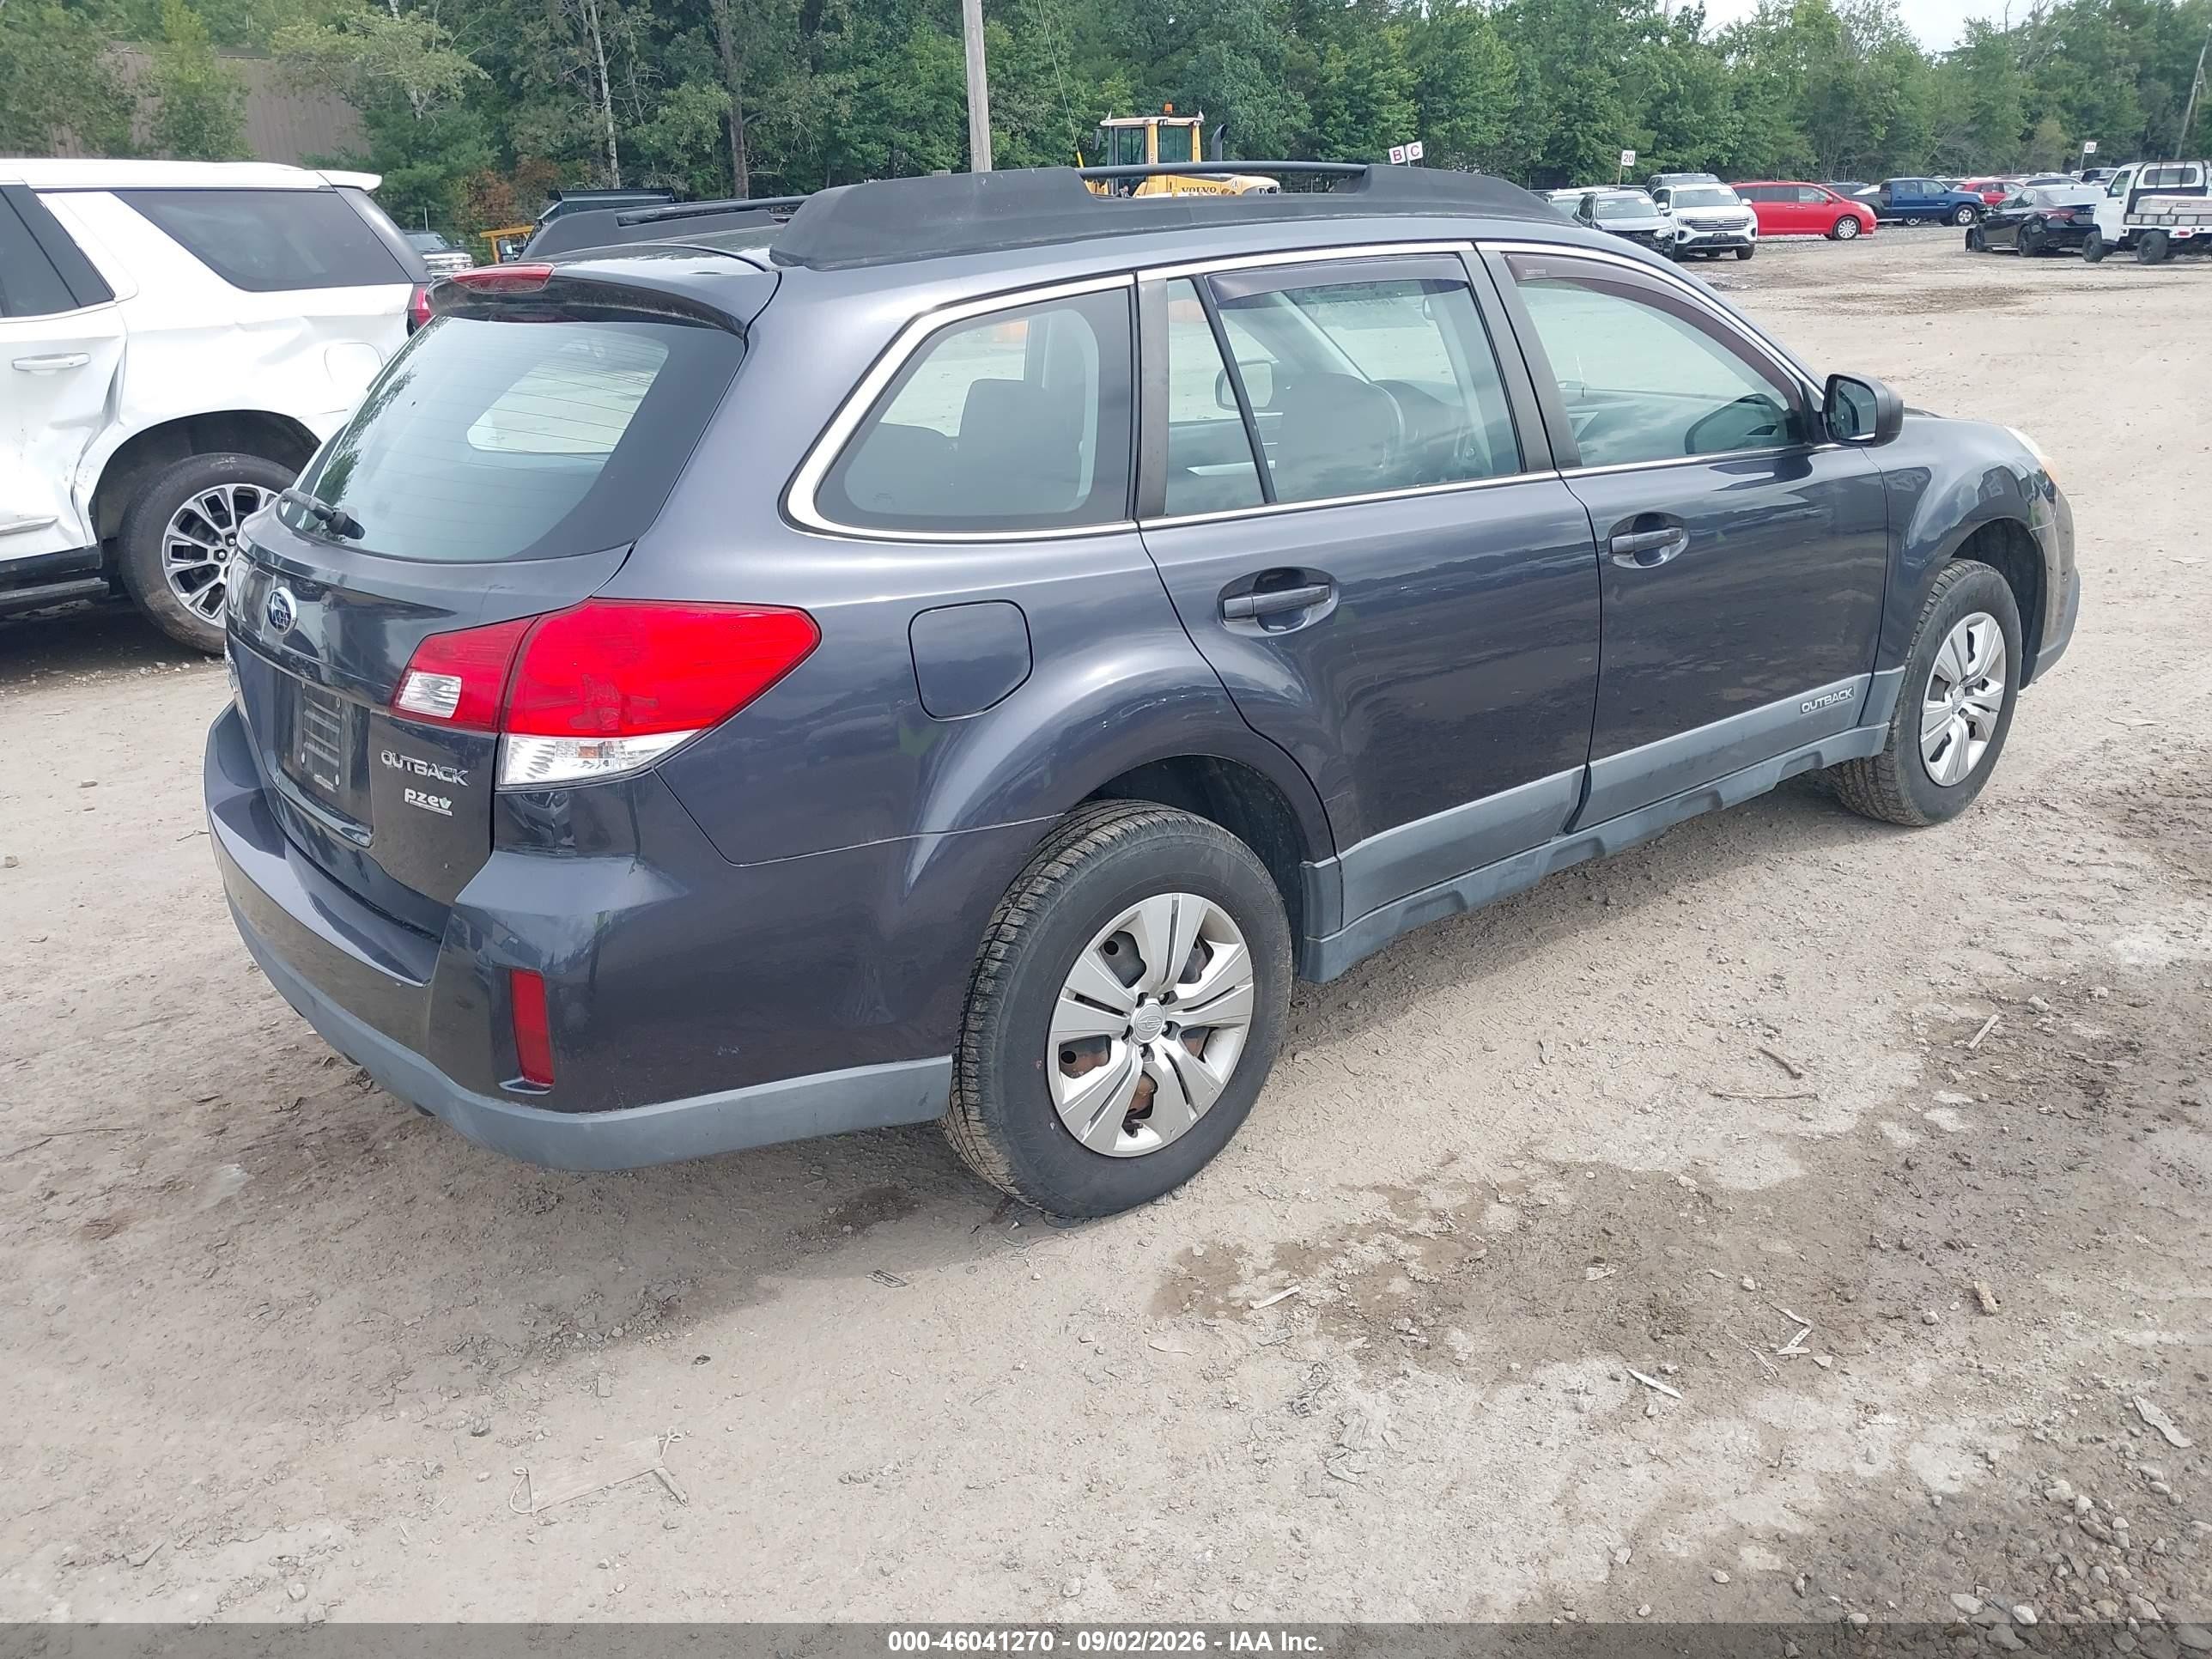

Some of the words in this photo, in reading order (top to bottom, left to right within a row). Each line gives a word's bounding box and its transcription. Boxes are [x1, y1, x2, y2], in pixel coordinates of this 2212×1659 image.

[1393, 149, 1402, 161] B
[1410, 145, 1419, 156] C
[1623, 154, 1634, 163] 20
[1801, 687, 1853, 714] OUTBACK
[380, 750, 471, 787] OUTBACK
